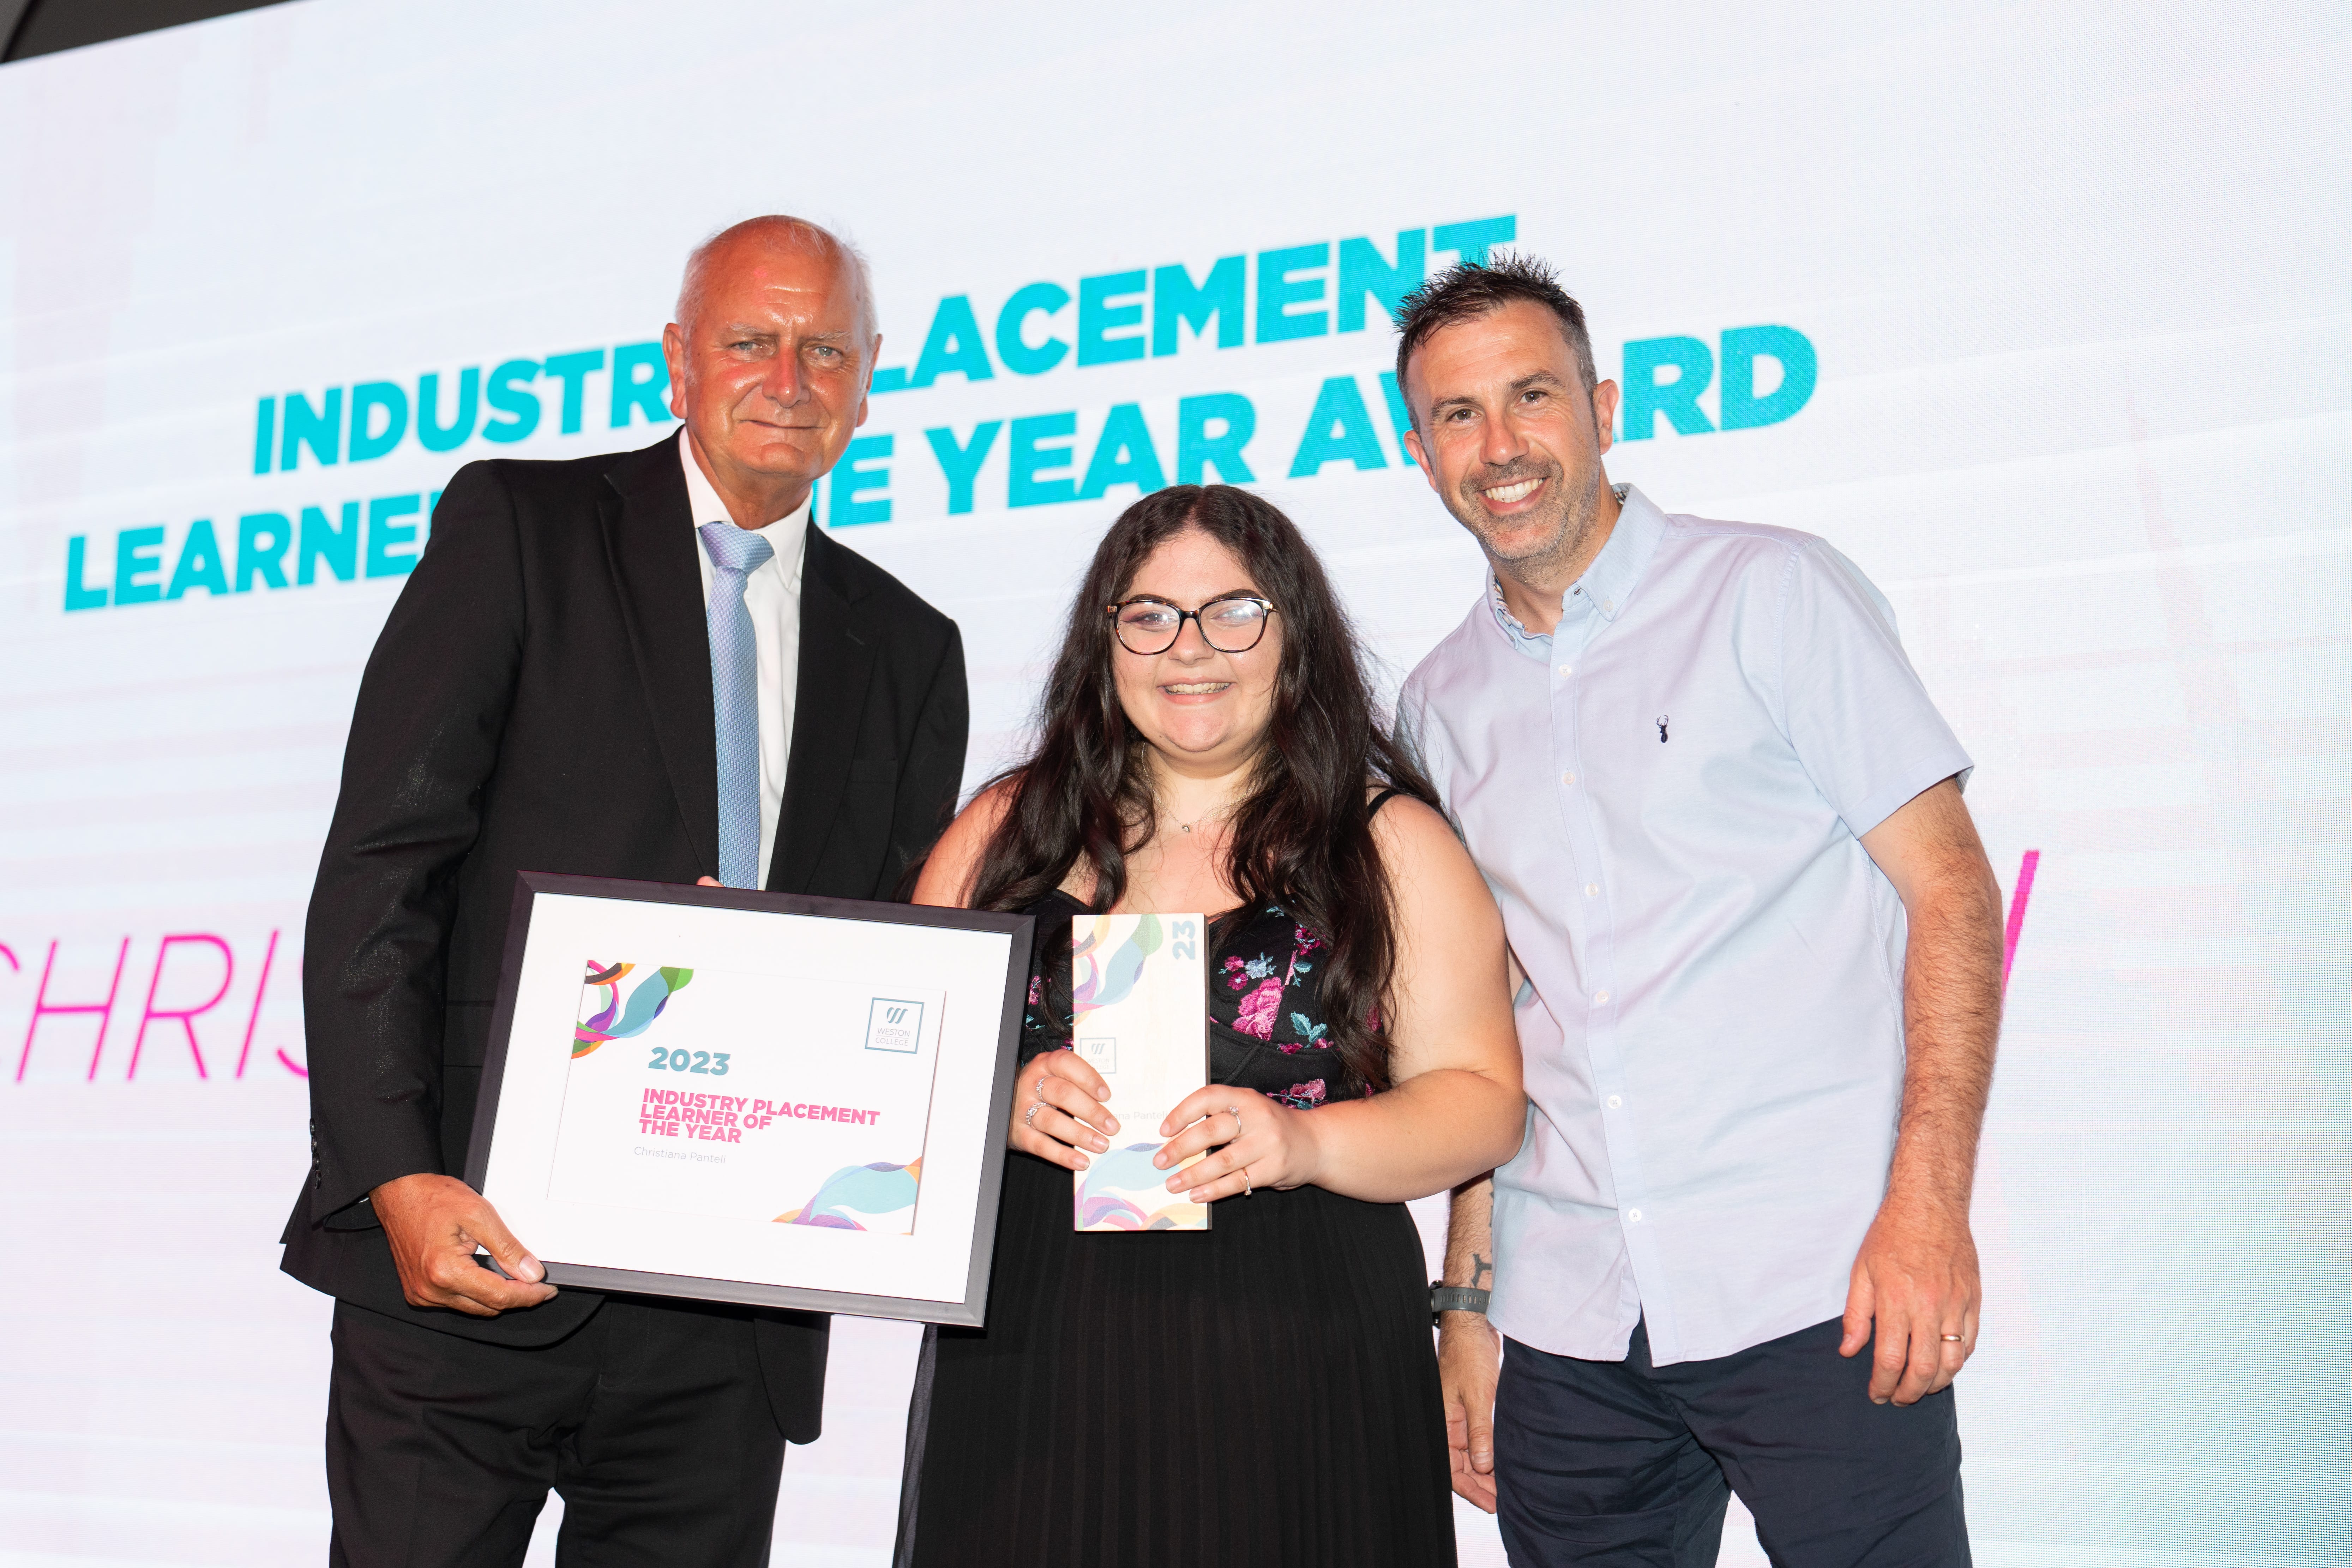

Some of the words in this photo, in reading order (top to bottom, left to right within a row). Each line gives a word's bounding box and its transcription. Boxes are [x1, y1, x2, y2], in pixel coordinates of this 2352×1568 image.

[254, 341, 674, 475] INDUSTR
[64, 489, 445, 613] LEARNE
[922, 392, 1258, 517] YEAR
[1288, 323, 1819, 479] ARD
[1172, 920, 1196, 960] 23
[875, 1037, 909, 1046] COLLEGE
[877, 1028, 910, 1037] WESTON
[648, 1046, 731, 1076] 2023
[640, 1103, 738, 1127] LEARNER
[743, 1114, 772, 1130] OF
[643, 1088, 748, 1112] INDUSTRY
[753, 1099, 880, 1125] PLACEMENT
[639, 1118, 680, 1137] THE
[685, 1123, 741, 1143] YEAR
[634, 1146, 686, 1160] Christiana
[690, 1152, 726, 1164] Panteli
